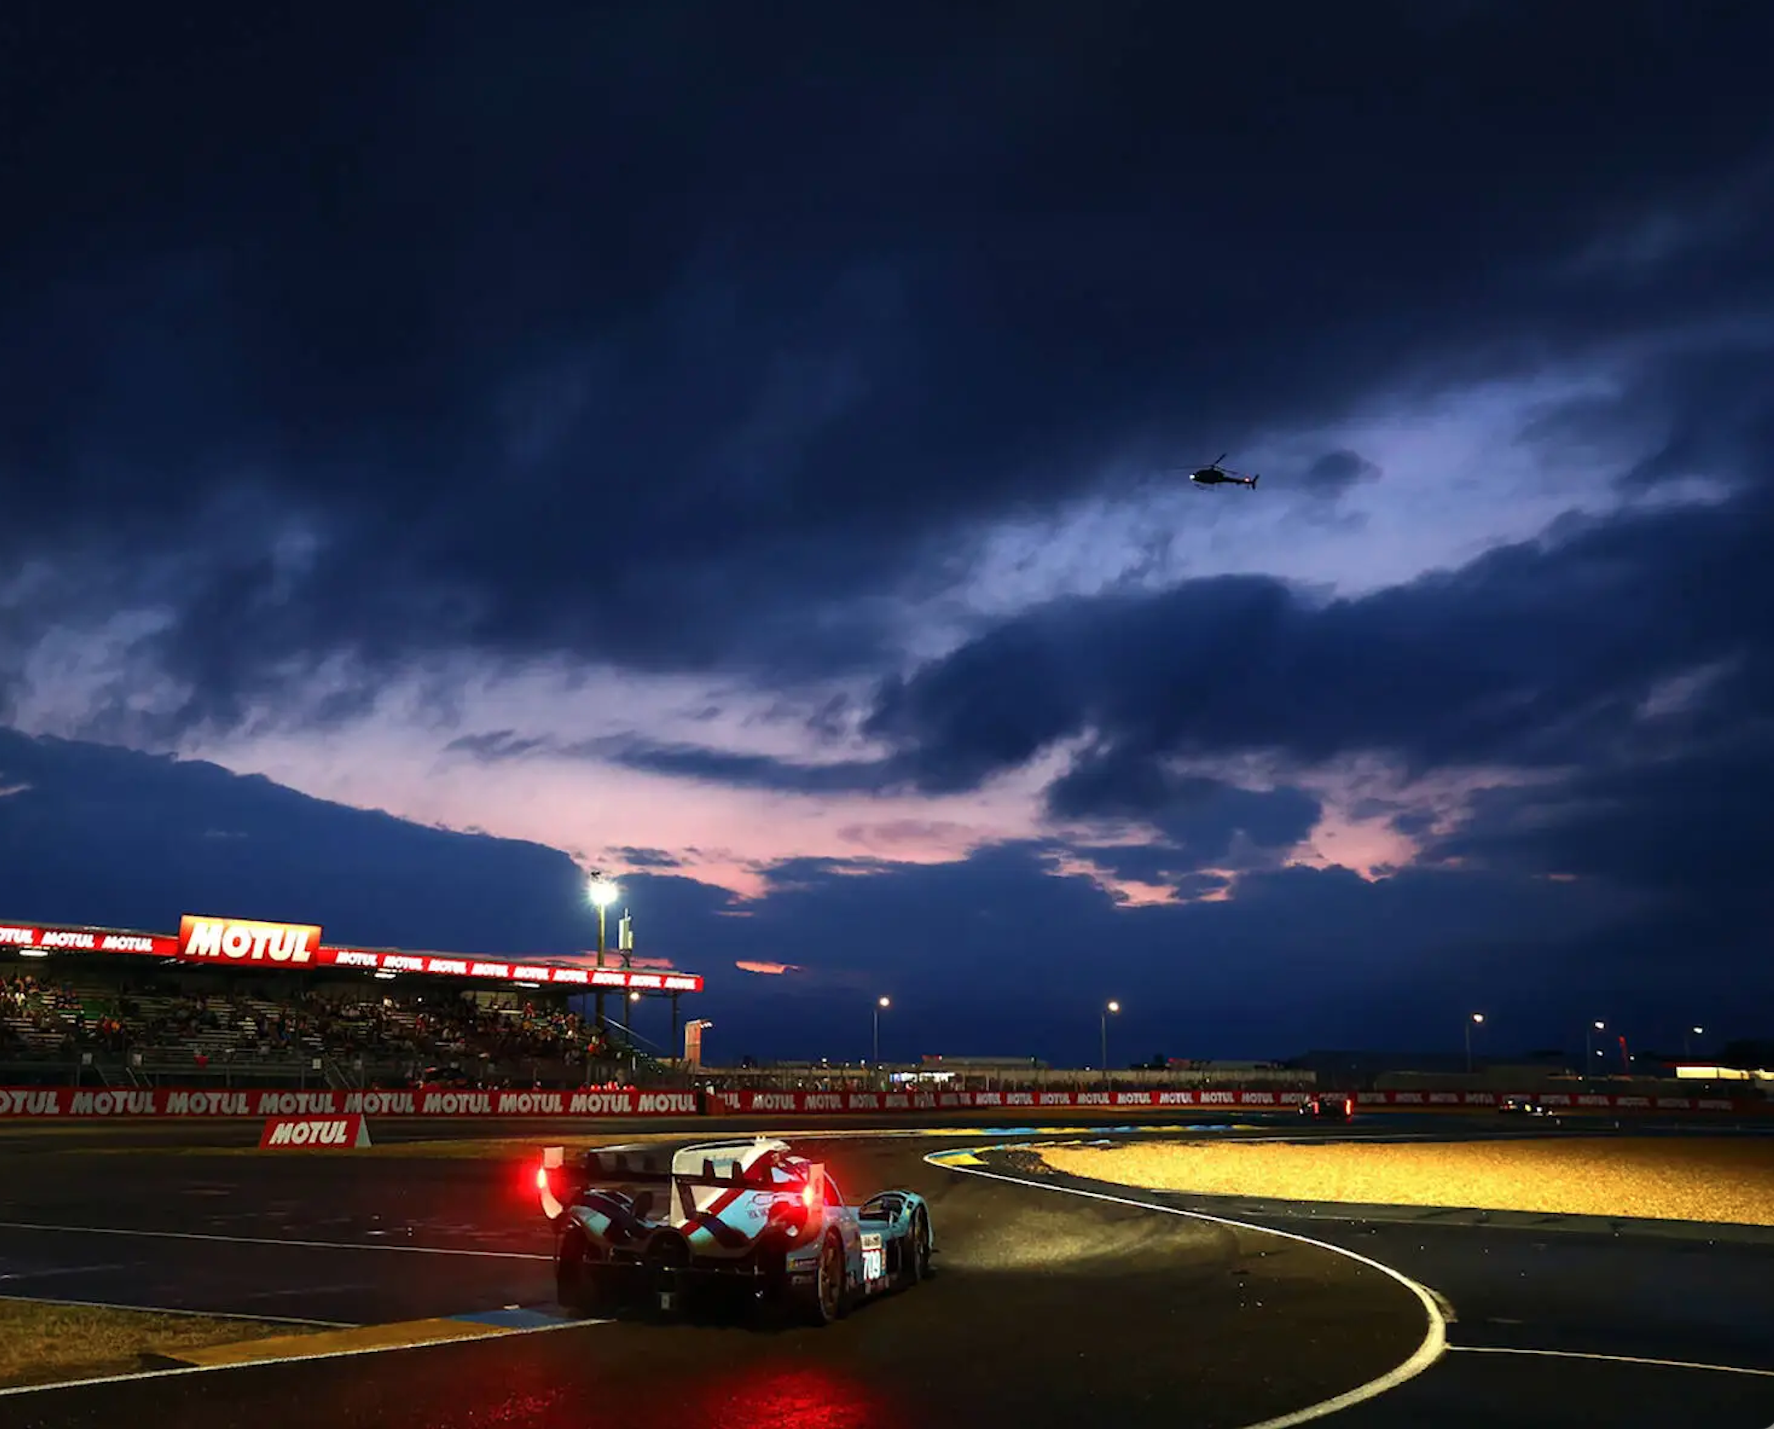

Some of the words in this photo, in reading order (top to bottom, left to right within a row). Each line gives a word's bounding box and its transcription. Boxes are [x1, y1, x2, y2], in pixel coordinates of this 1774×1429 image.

[0, 926, 33, 945] OTUL
[41, 931, 94, 948] MOTUL
[101, 935, 153, 951] MOTUL
[185, 921, 311, 962] MOTUL
[336, 951, 378, 966] MOTUL
[383, 955, 423, 970] MOTUL
[427, 959, 467, 974] MOTUL
[471, 963, 508, 977] MOTUL
[0, 1090, 60, 1114] OTUL
[69, 1091, 155, 1114] MOTUL
[166, 1092, 249, 1114] MOTUL
[258, 1093, 336, 1114] MOTUL
[344, 1093, 415, 1114] MOTUL
[422, 1093, 492, 1113] MOTUL
[498, 1094, 563, 1113] MOTUL
[569, 1094, 632, 1113] MOTUL
[638, 1094, 697, 1112] MOTUL
[752, 1094, 796, 1110] MOTUL
[804, 1094, 843, 1109] MOTUL
[1040, 1092, 1071, 1105] MOTUL
[1077, 1092, 1111, 1105] MOTUL
[1117, 1092, 1152, 1105] MOTUL
[1159, 1092, 1194, 1104] MOTUL
[1200, 1092, 1235, 1104] MOTUL
[1241, 1092, 1274, 1104] MOTUL
[269, 1121, 348, 1145] MOTUL
